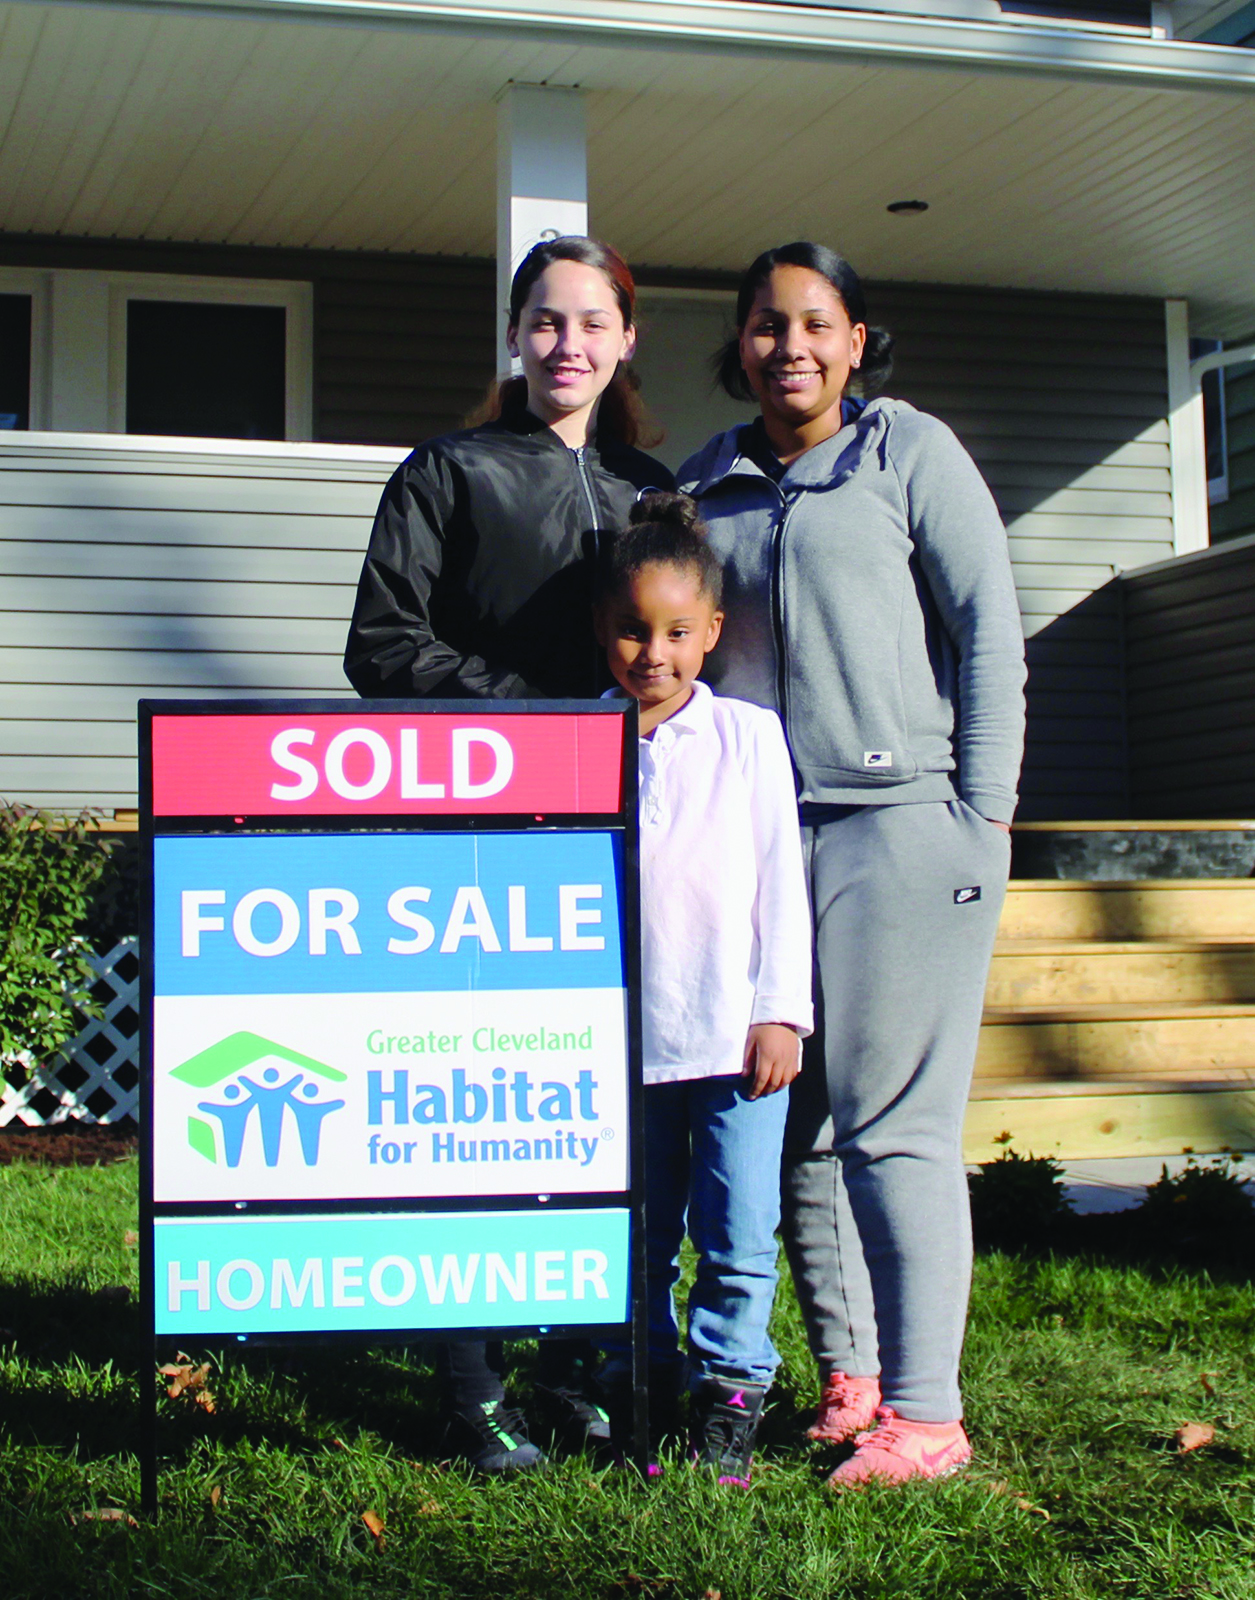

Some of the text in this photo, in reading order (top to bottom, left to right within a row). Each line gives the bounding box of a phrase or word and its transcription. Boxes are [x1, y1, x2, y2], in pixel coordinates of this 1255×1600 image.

[270, 727, 514, 801] SOLD
[181, 884, 606, 957] FOR SALE
[366, 1026, 593, 1054] Greater Cleveland
[366, 1066, 599, 1126] Habitat
[367, 1133, 418, 1165] for
[167, 1249, 610, 1312] HOMEOWNER
